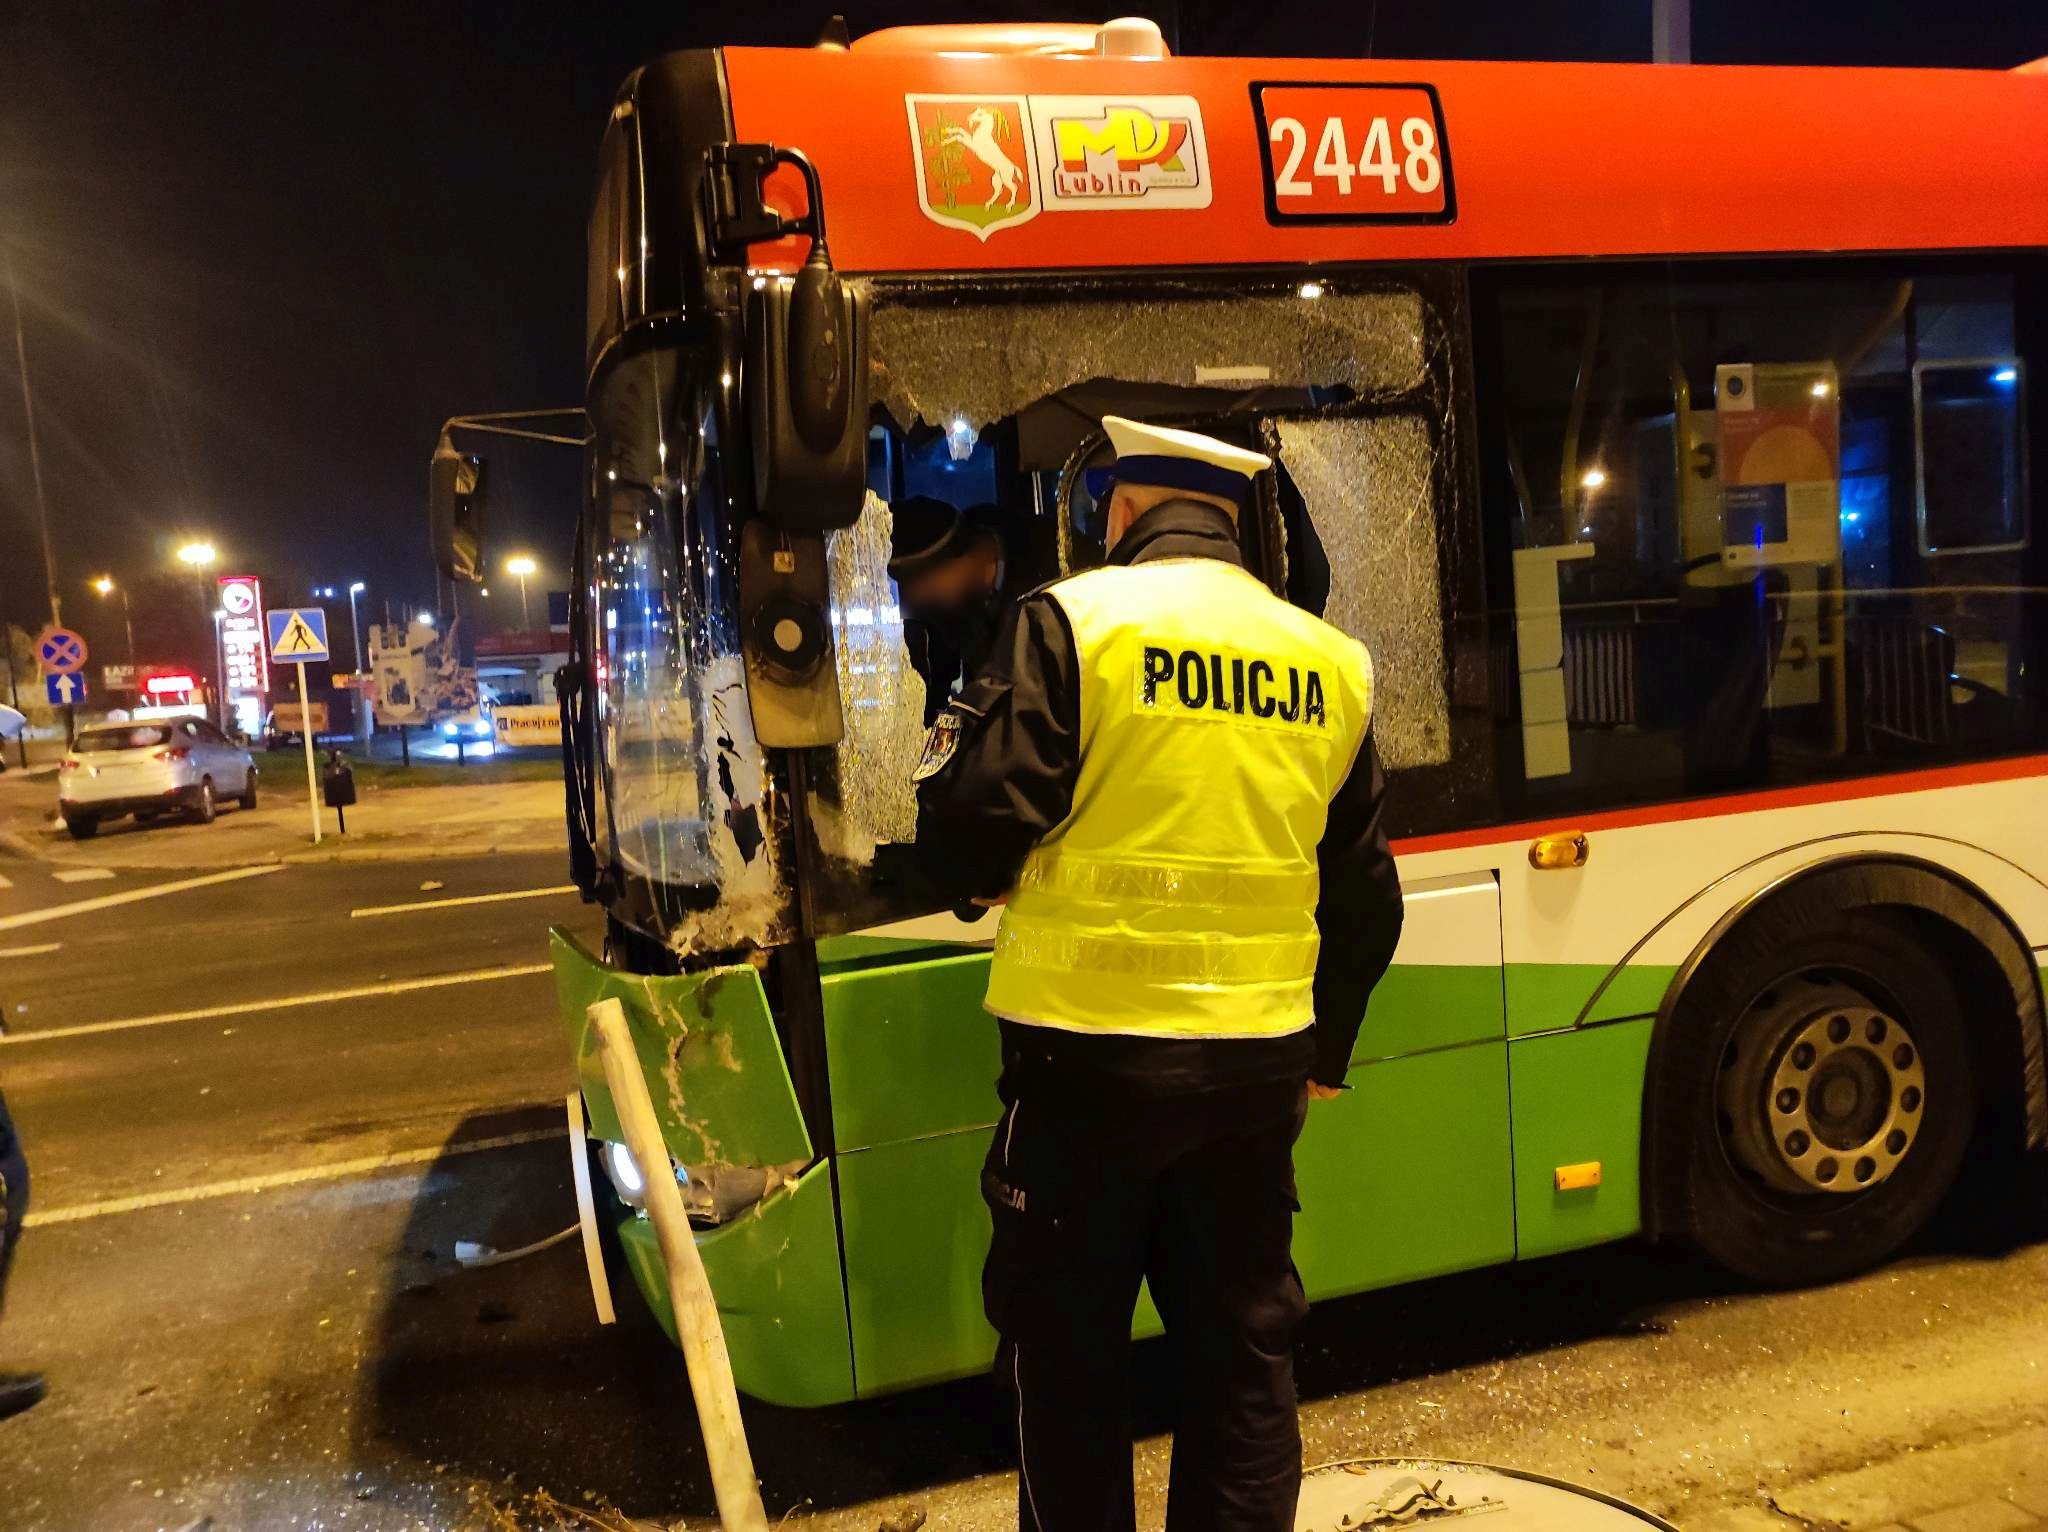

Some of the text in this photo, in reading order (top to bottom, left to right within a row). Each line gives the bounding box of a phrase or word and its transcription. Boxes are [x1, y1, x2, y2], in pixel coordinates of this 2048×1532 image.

[1059, 173, 1140, 196] Lublin
[1270, 117, 1440, 195] 2448
[1144, 646, 1326, 728] POLICJA
